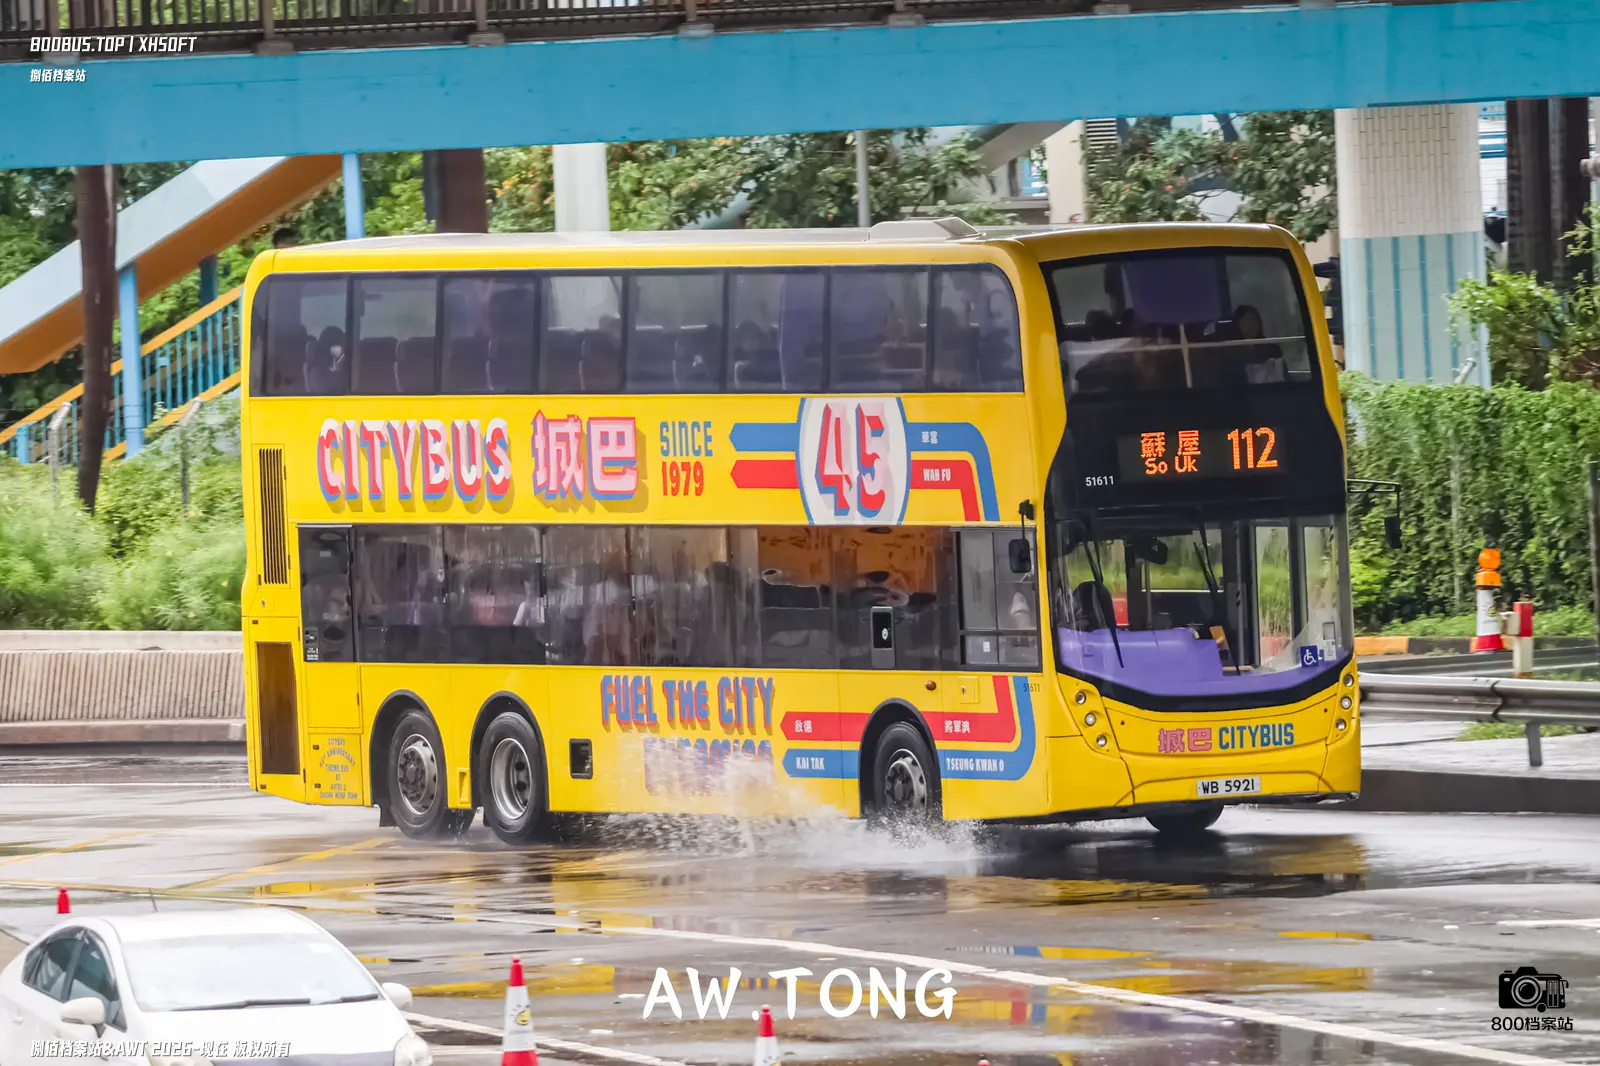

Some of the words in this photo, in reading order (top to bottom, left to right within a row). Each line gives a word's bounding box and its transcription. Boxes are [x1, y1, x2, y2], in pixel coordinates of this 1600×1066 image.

[659, 420, 714, 458] SINCE
[1227, 426, 1278, 470] 112
[316, 417, 513, 502] CITYBUS
[530, 409, 639, 501] 城巴
[814, 402, 895, 518] 45
[1144, 457, 1168, 475] So
[1174, 455, 1198, 473] Uk
[660, 460, 705, 498] 1979
[923, 468, 940, 482] WAH
[941, 468, 952, 482] FU
[1085, 475, 1114, 487] 51611
[600, 675, 658, 728] FUEL
[662, 679, 711, 727] THE
[717, 676, 774, 730] CITY
[1158, 727, 1213, 753] 城巴
[1218, 723, 1295, 750] CITYBUS
[795, 756, 809, 770] KAI
[810, 757, 825, 770] TAK
[946, 757, 974, 771] TSEUNG
[975, 758, 998, 772] KWAN
[1201, 780, 1219, 795] WB
[1224, 778, 1255, 793] 5921
